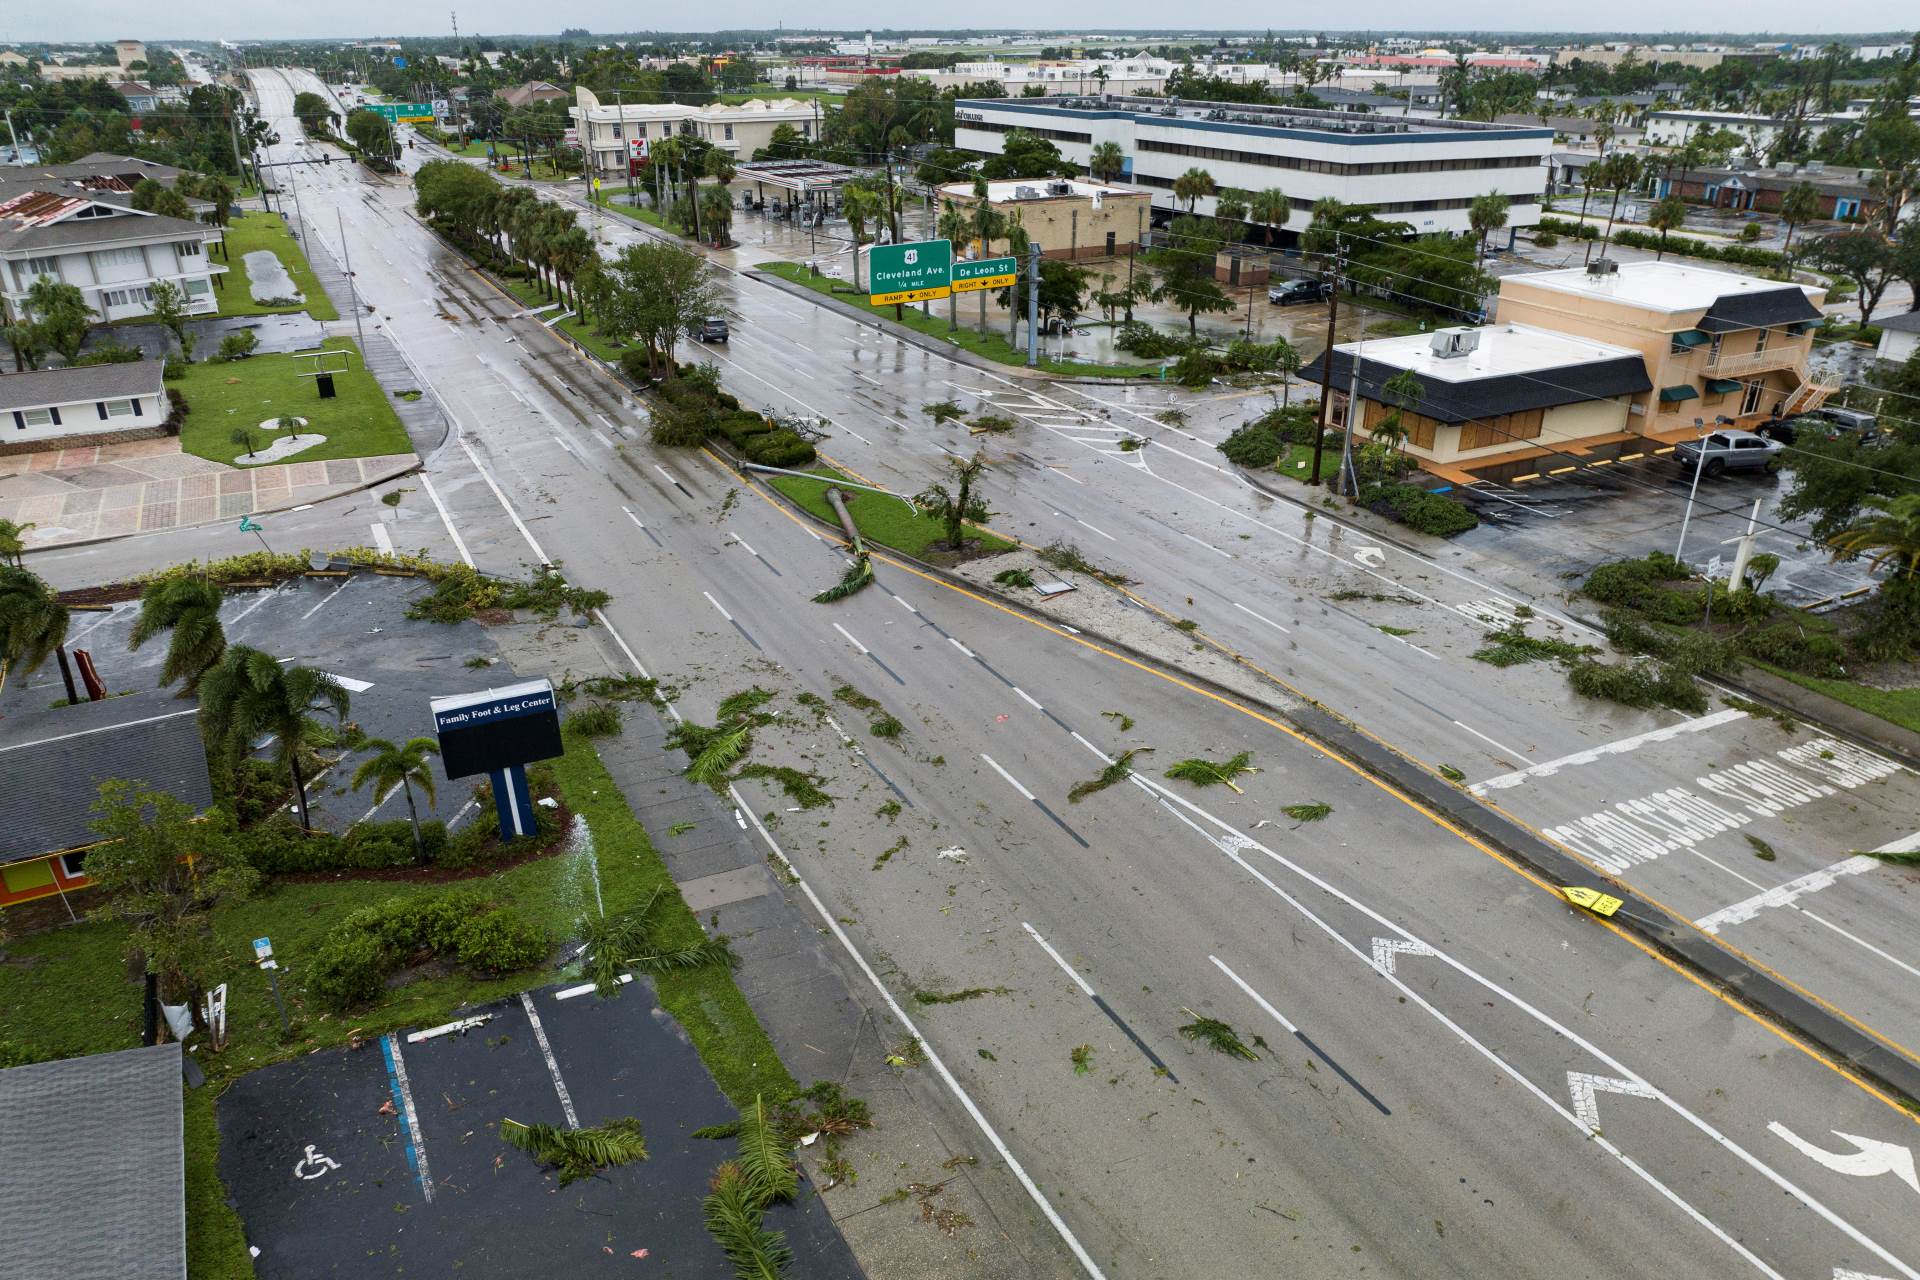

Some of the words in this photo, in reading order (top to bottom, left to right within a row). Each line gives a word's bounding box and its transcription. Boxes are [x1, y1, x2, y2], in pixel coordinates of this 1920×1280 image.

[907, 252, 916, 262] 41
[876, 268, 922, 280] Cleveland
[926, 266, 945, 275] Ave.
[960, 268, 970, 277] De
[974, 266, 995, 275] Leon
[998, 264, 1008, 272] St
[958, 281, 977, 289] RIGHT
[992, 277, 1009, 285] ONLY
[884, 293, 904, 302] RAMP
[919, 290, 937, 298] ONLY
[440, 713, 470, 725] Family
[471, 709, 492, 719] Foot
[493, 706, 502, 714] &
[503, 704, 520, 712] Leg
[521, 697, 551, 708] Center
[1542, 811, 1681, 876] SCHOOL
[1615, 786, 1752, 848] SCHOOL
[1696, 758, 1838, 818] SCHOOL
